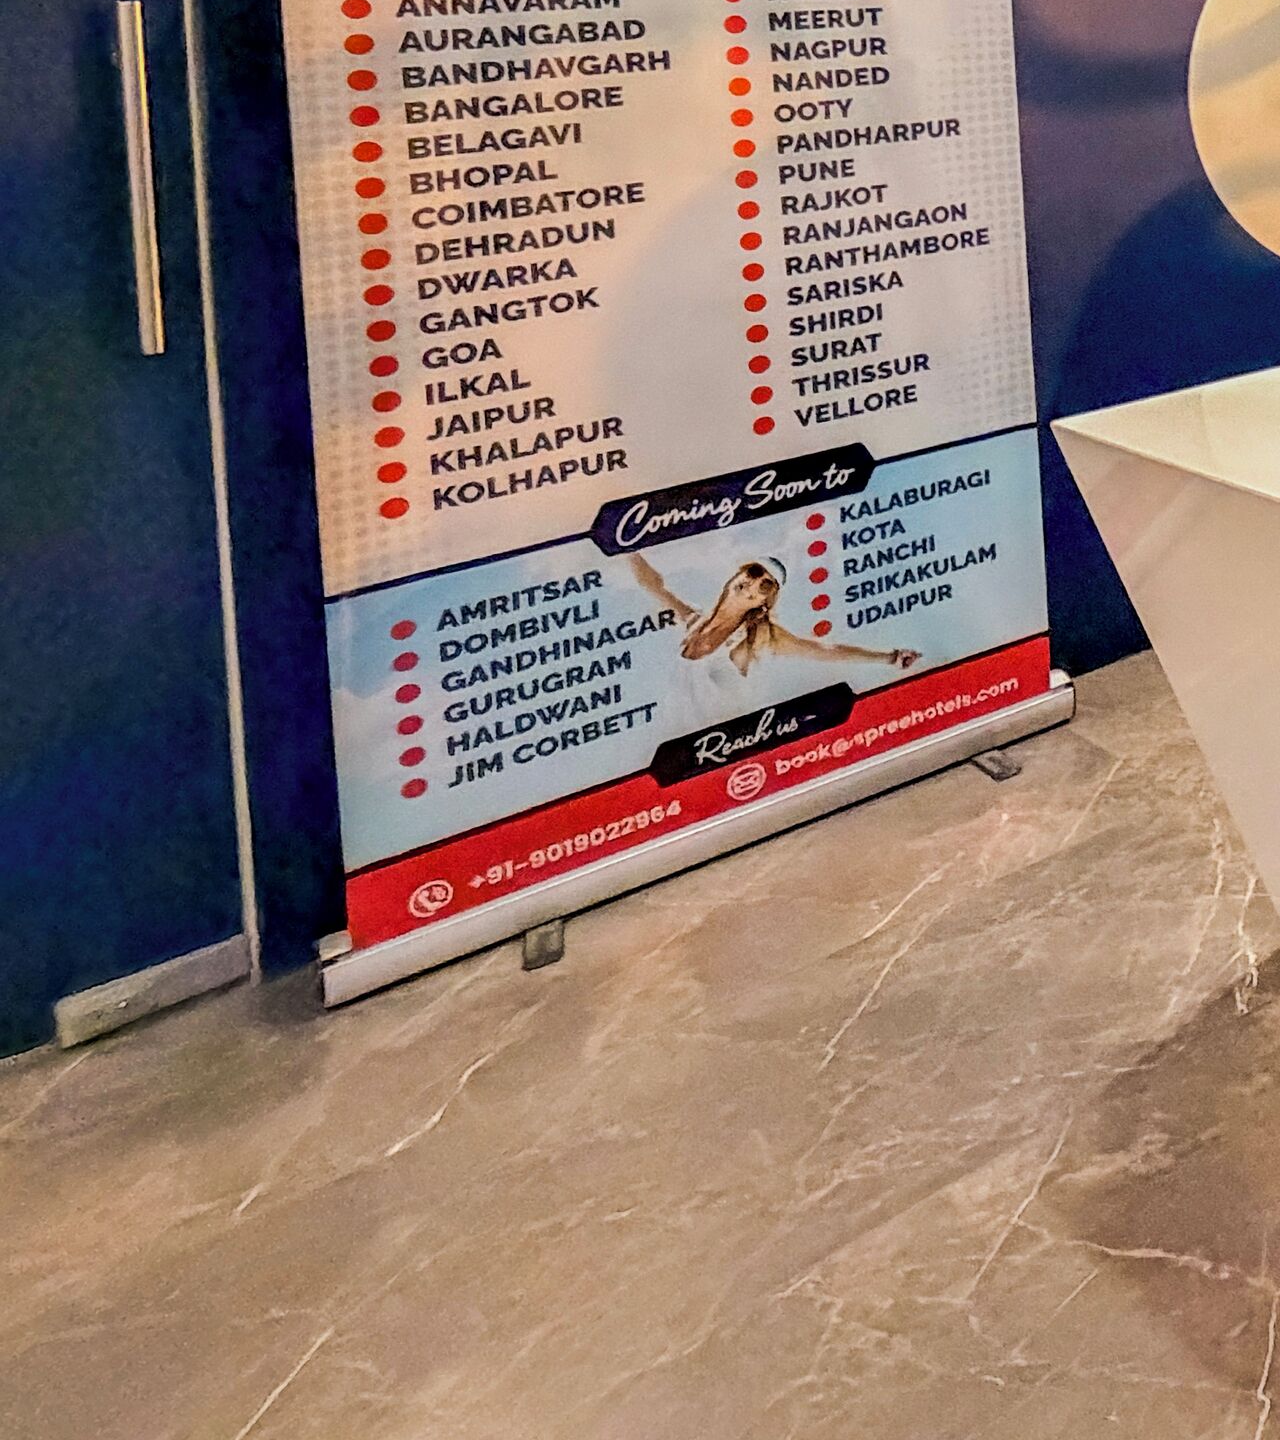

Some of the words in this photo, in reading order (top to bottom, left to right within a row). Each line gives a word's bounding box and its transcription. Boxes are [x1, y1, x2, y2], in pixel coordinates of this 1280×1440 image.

[398, 19, 646, 53] AURANGABAD
[768, 7, 883, 32] MEERUT
[402, 50, 671, 89] BANDHAVGARH
[770, 37, 888, 62] NAGPUR
[772, 66, 890, 93] NANDED
[404, 86, 624, 124] BANGALORE
[774, 98, 853, 123] OOTY
[407, 123, 582, 160] BELAGAVI
[777, 118, 961, 155] PANDHARPUR
[409, 160, 558, 195] BHOPAL
[778, 159, 856, 185] PUNE
[411, 182, 646, 229] COIMBATORE
[780, 184, 888, 215] RAJKOT
[415, 218, 616, 265] DEHRADUN
[783, 202, 968, 246] RANJANGAON
[785, 227, 990, 276] RANTHAMBORE
[417, 257, 578, 300] DWARKA
[787, 270, 904, 306] SARISKA
[419, 287, 600, 335] GANGTOK
[788, 303, 883, 337] SHIRDI
[422, 338, 503, 370] GOA
[791, 332, 882, 367] SURAT
[425, 369, 532, 406] ILKAL
[792, 353, 931, 397] THRISSUR
[426, 397, 557, 441] JAIPUR
[794, 384, 918, 427] VELLORE
[430, 416, 625, 476] KHALAPUR
[433, 449, 629, 511] KOLHAPUR
[840, 469, 991, 523] KALABURAGI
[615, 499, 742, 547] Coming
[744, 469, 820, 510] Soon
[822, 463, 856, 490] to
[842, 518, 906, 550] KOTA
[843, 534, 936, 577] RANCHI
[845, 543, 997, 603] SRIKAKULAM
[435, 570, 604, 632] AMRITSAR
[847, 583, 953, 629] UDAIPUR
[438, 599, 600, 662] DOMBIVLI
[440, 608, 678, 693] GANDHINAGAR
[443, 650, 632, 723] GURUGRAM
[446, 684, 622, 756] HALDWANI
[693, 708, 776, 765] Reach
[776, 718, 798, 738] us
[774, 677, 1019, 775] book@spreehotels.com
[448, 751, 505, 789] JIM
[512, 702, 658, 767] CORBETT
